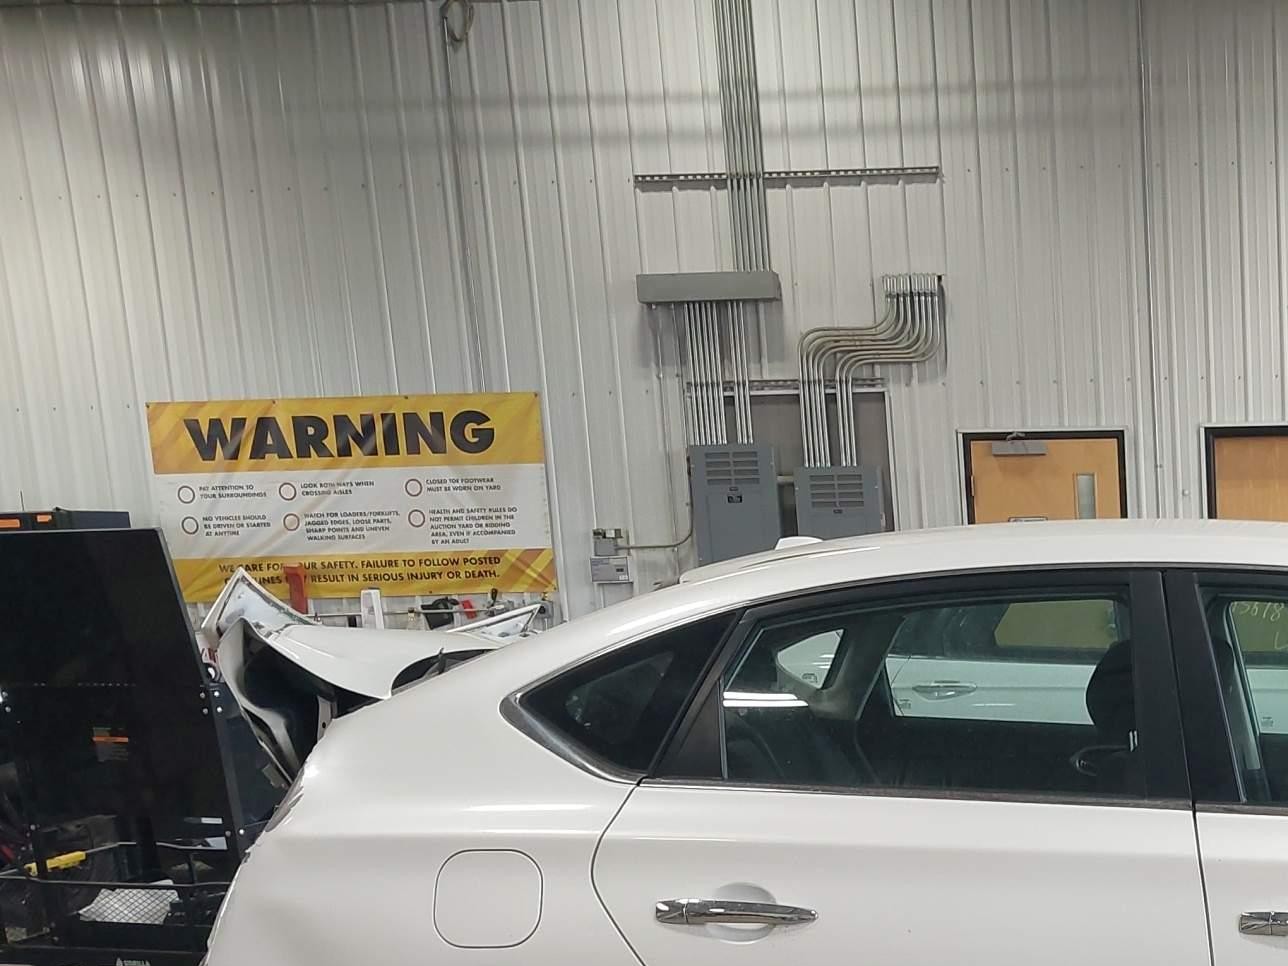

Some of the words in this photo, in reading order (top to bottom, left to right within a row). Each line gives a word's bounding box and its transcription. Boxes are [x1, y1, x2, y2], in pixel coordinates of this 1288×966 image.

[184, 410, 495, 461] WARNING
[219, 564, 235, 573] WE
[298, 561, 317, 570] UR
[321, 561, 357, 569] SAFETY.
[361, 559, 399, 568] FAILURE
[403, 559, 415, 567] TO
[419, 558, 460, 567] FOLLOW
[463, 556, 500, 566] POSTED
[311, 574, 345, 583] RESULT
[348, 574, 359, 582] IN
[363, 572, 404, 582] SERIOUS
[407, 571, 443, 581] INJURY
[447, 571, 462, 579] OR
[465, 570, 500, 579] DEATH.
